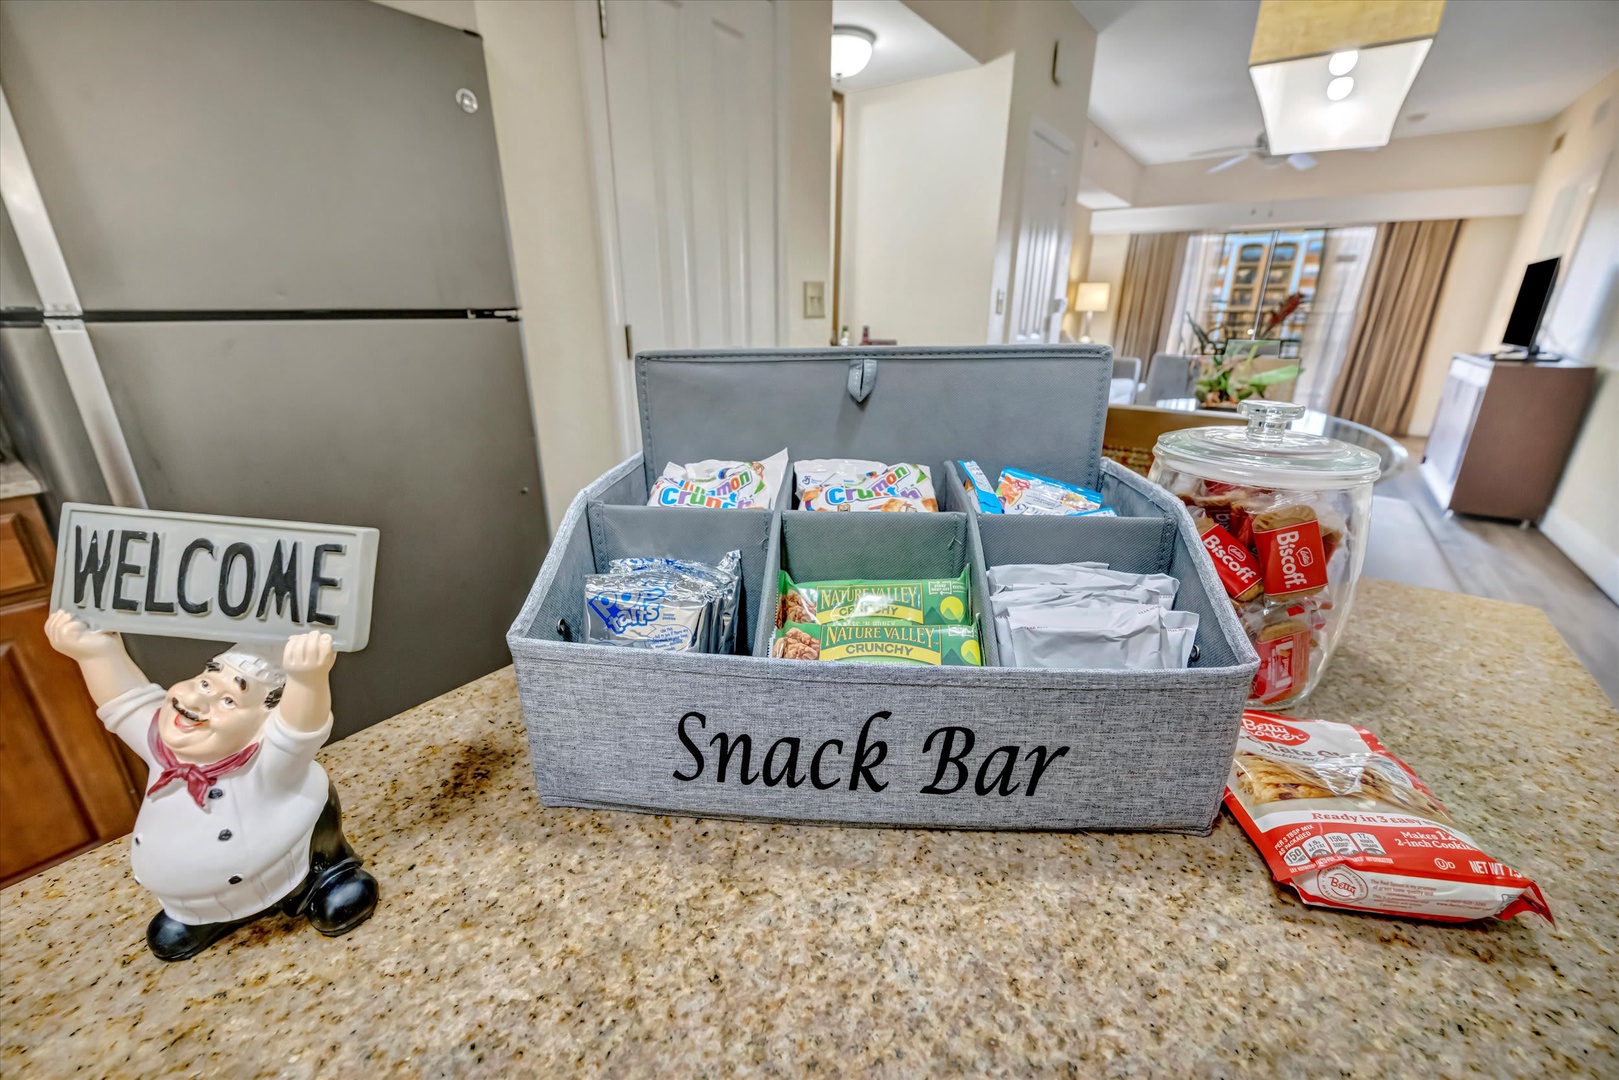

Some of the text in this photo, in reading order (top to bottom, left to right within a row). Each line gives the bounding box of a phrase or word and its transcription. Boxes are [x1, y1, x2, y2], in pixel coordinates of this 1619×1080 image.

[1203, 534, 1257, 583] Biscoff
[1276, 530, 1307, 588] Biscoff
[73, 524, 344, 627] WELCOME
[825, 626, 935, 649] NATURE VALLEY
[845, 643, 914, 656] CRUNCHY
[1242, 719, 1287, 734] Betty
[672, 710, 1071, 797] Snack Bar
[1311, 812, 1422, 825] Ready in 3 easy
[1395, 838, 1432, 848] 2-inch
[1400, 831, 1438, 840] Makes
[1285, 848, 1302, 864] 150
[1468, 860, 1489, 874] NET
[1489, 861, 1505, 876] WT
[1328, 876, 1357, 896] Betty
